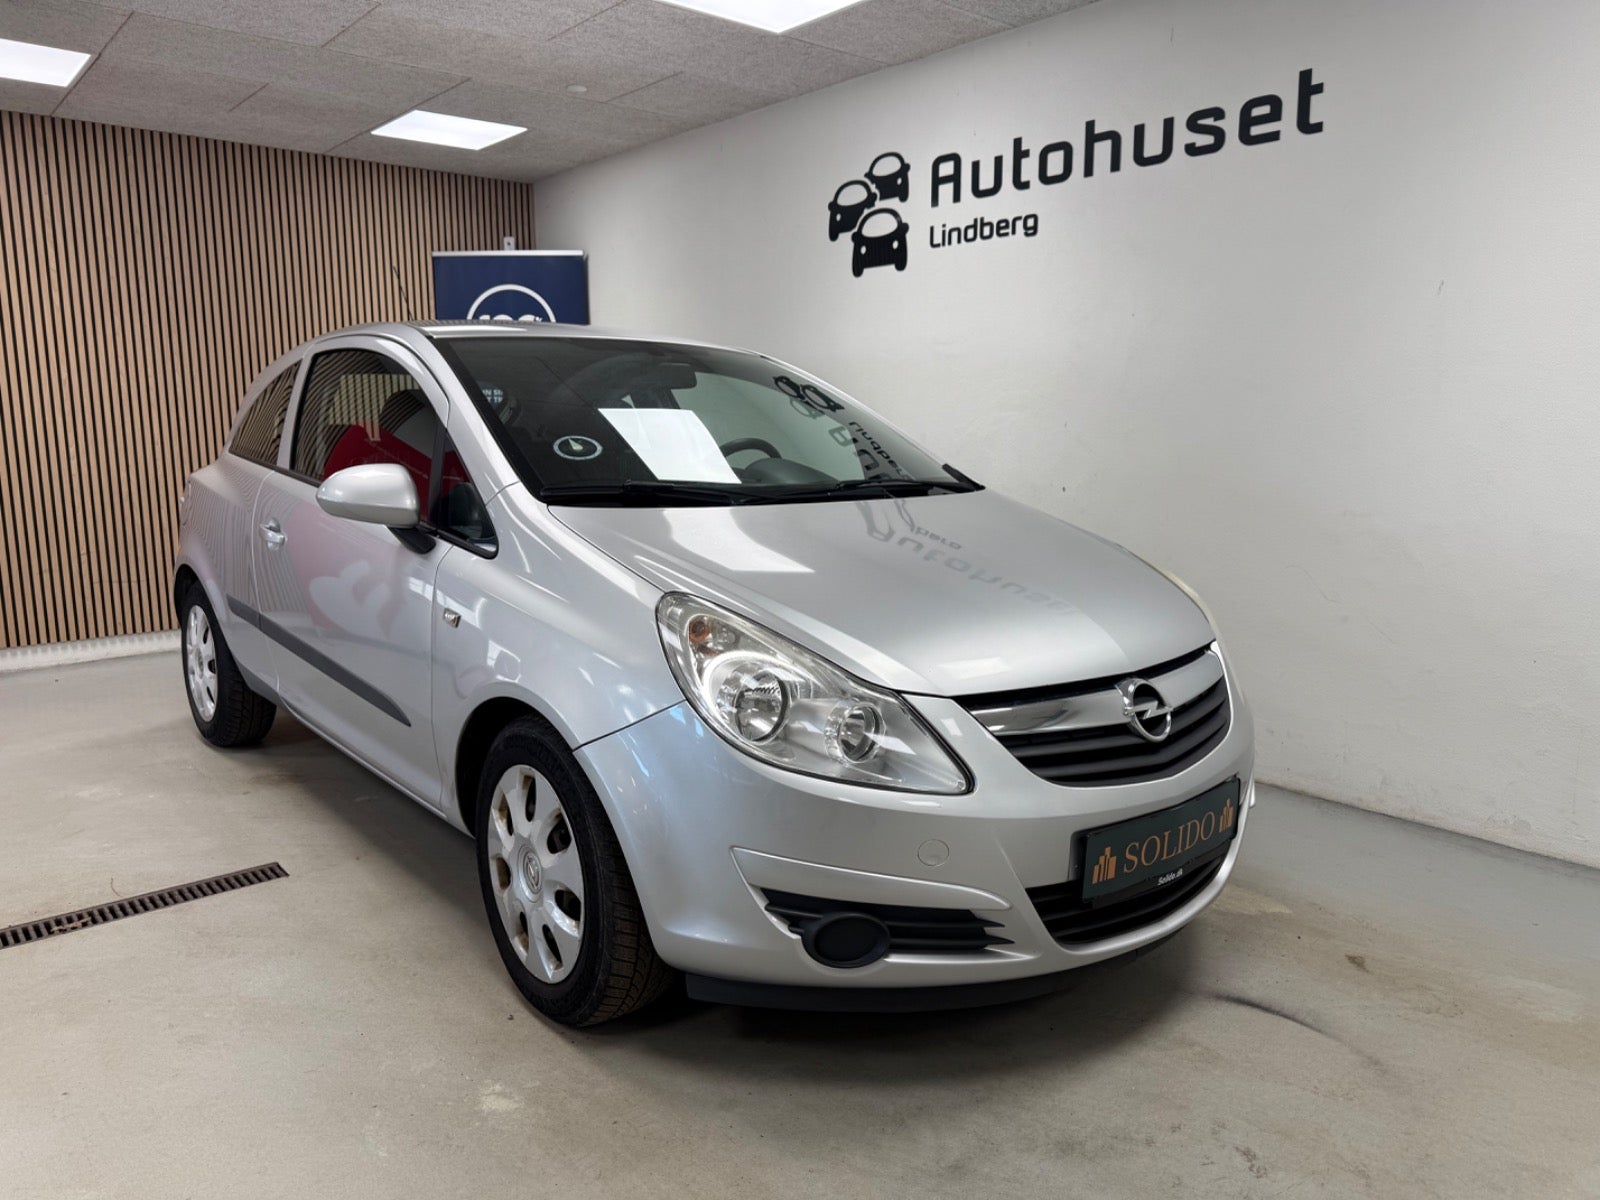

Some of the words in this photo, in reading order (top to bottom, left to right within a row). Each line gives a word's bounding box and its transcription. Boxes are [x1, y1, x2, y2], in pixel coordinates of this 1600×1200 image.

[931, 68, 1324, 207] Autohuset
[929, 213, 1040, 249] Lindberg
[1123, 811, 1215, 873] SOLIDO
